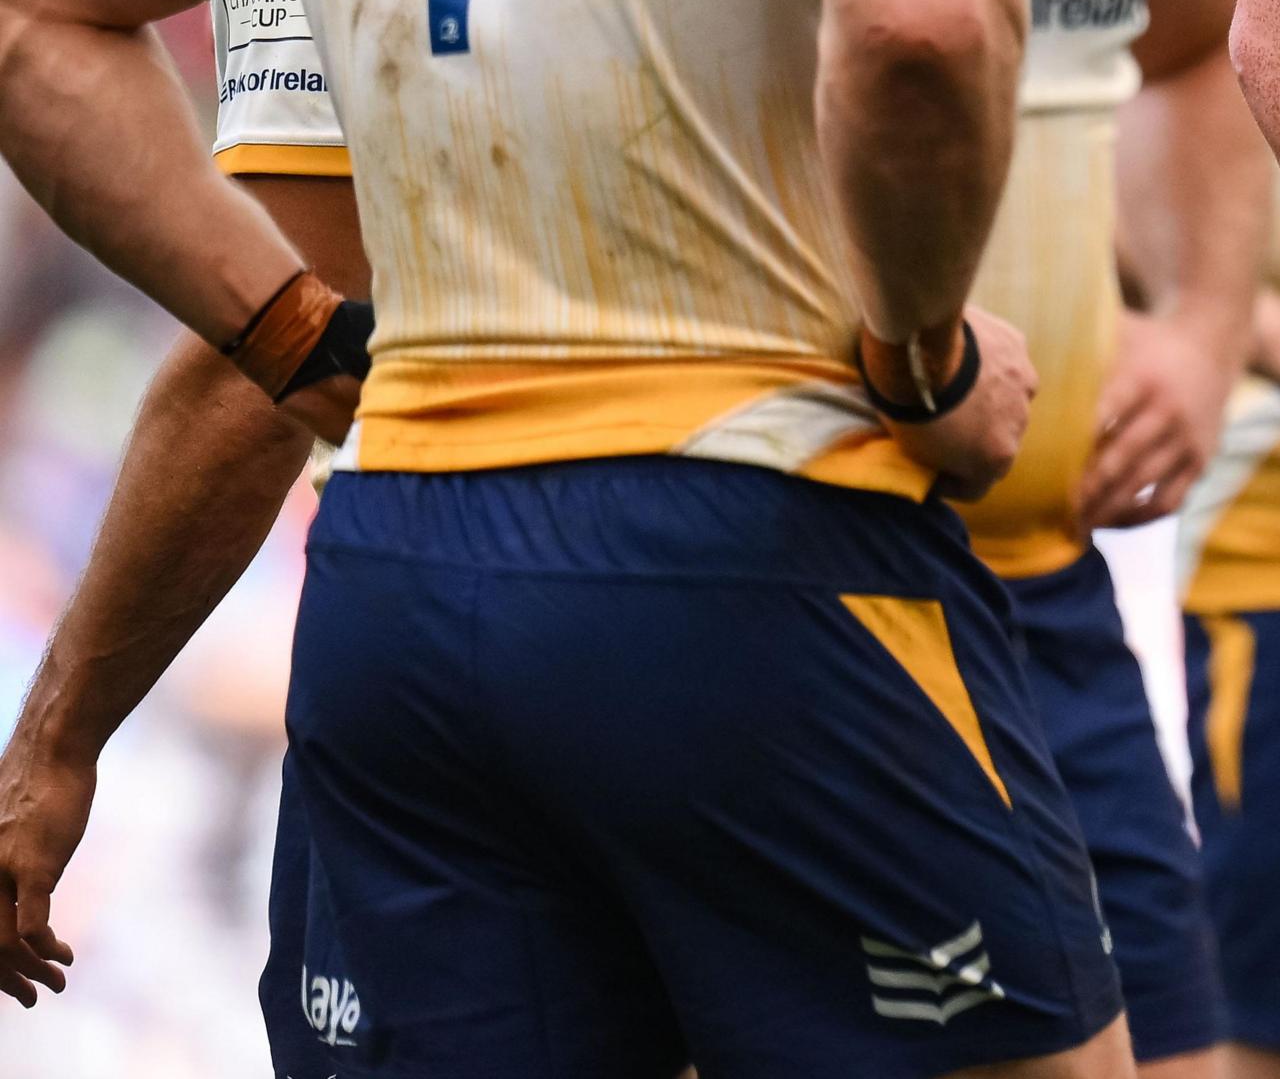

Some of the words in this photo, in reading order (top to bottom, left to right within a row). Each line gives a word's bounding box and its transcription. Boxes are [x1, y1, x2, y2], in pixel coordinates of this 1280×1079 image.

[251, 8, 287, 28] CUP
[247, 69, 269, 91] of
[269, 68, 328, 92] Irela
